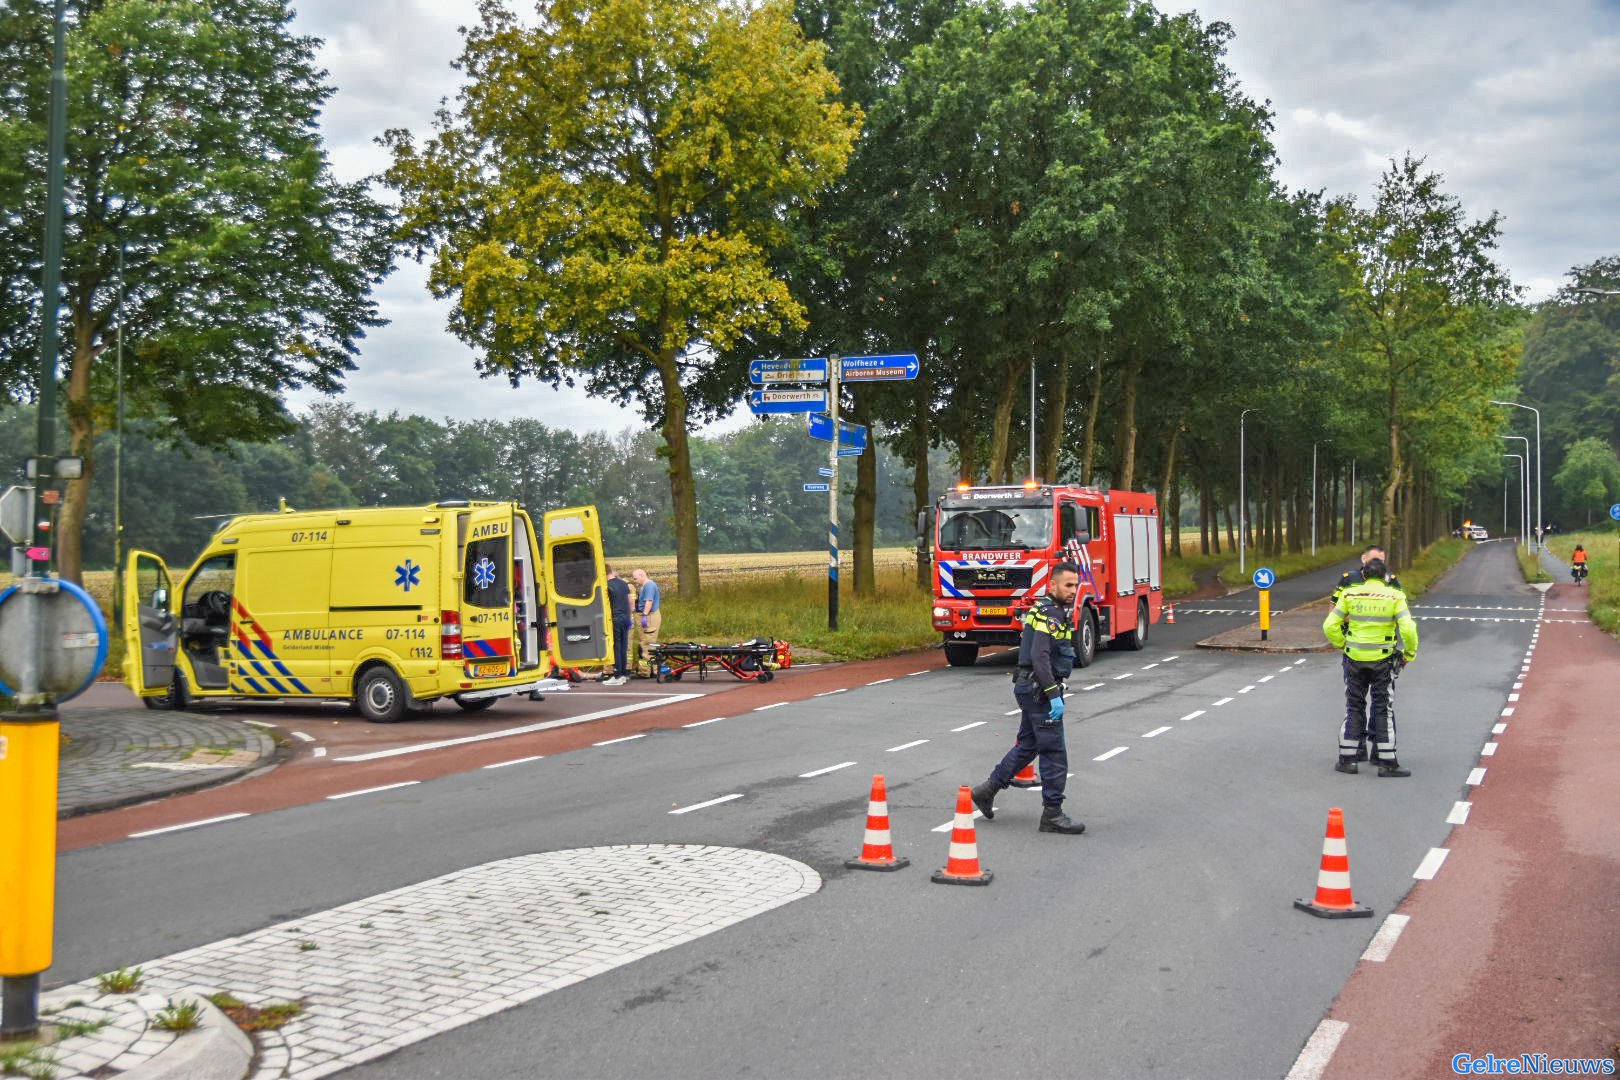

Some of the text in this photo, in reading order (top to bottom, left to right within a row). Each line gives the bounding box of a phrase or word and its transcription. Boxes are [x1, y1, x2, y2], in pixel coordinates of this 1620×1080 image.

[772, 392, 811, 400] Doorwerth
[472, 521, 508, 538] AMBU
[291, 530, 328, 543] 07-114
[962, 552, 1022, 560] BRANDWEER
[977, 573, 1006, 581] MAN
[478, 612, 509, 623] 07-114
[283, 629, 426, 641] AMBULANCE 07-114
[415, 647, 434, 658] 112
